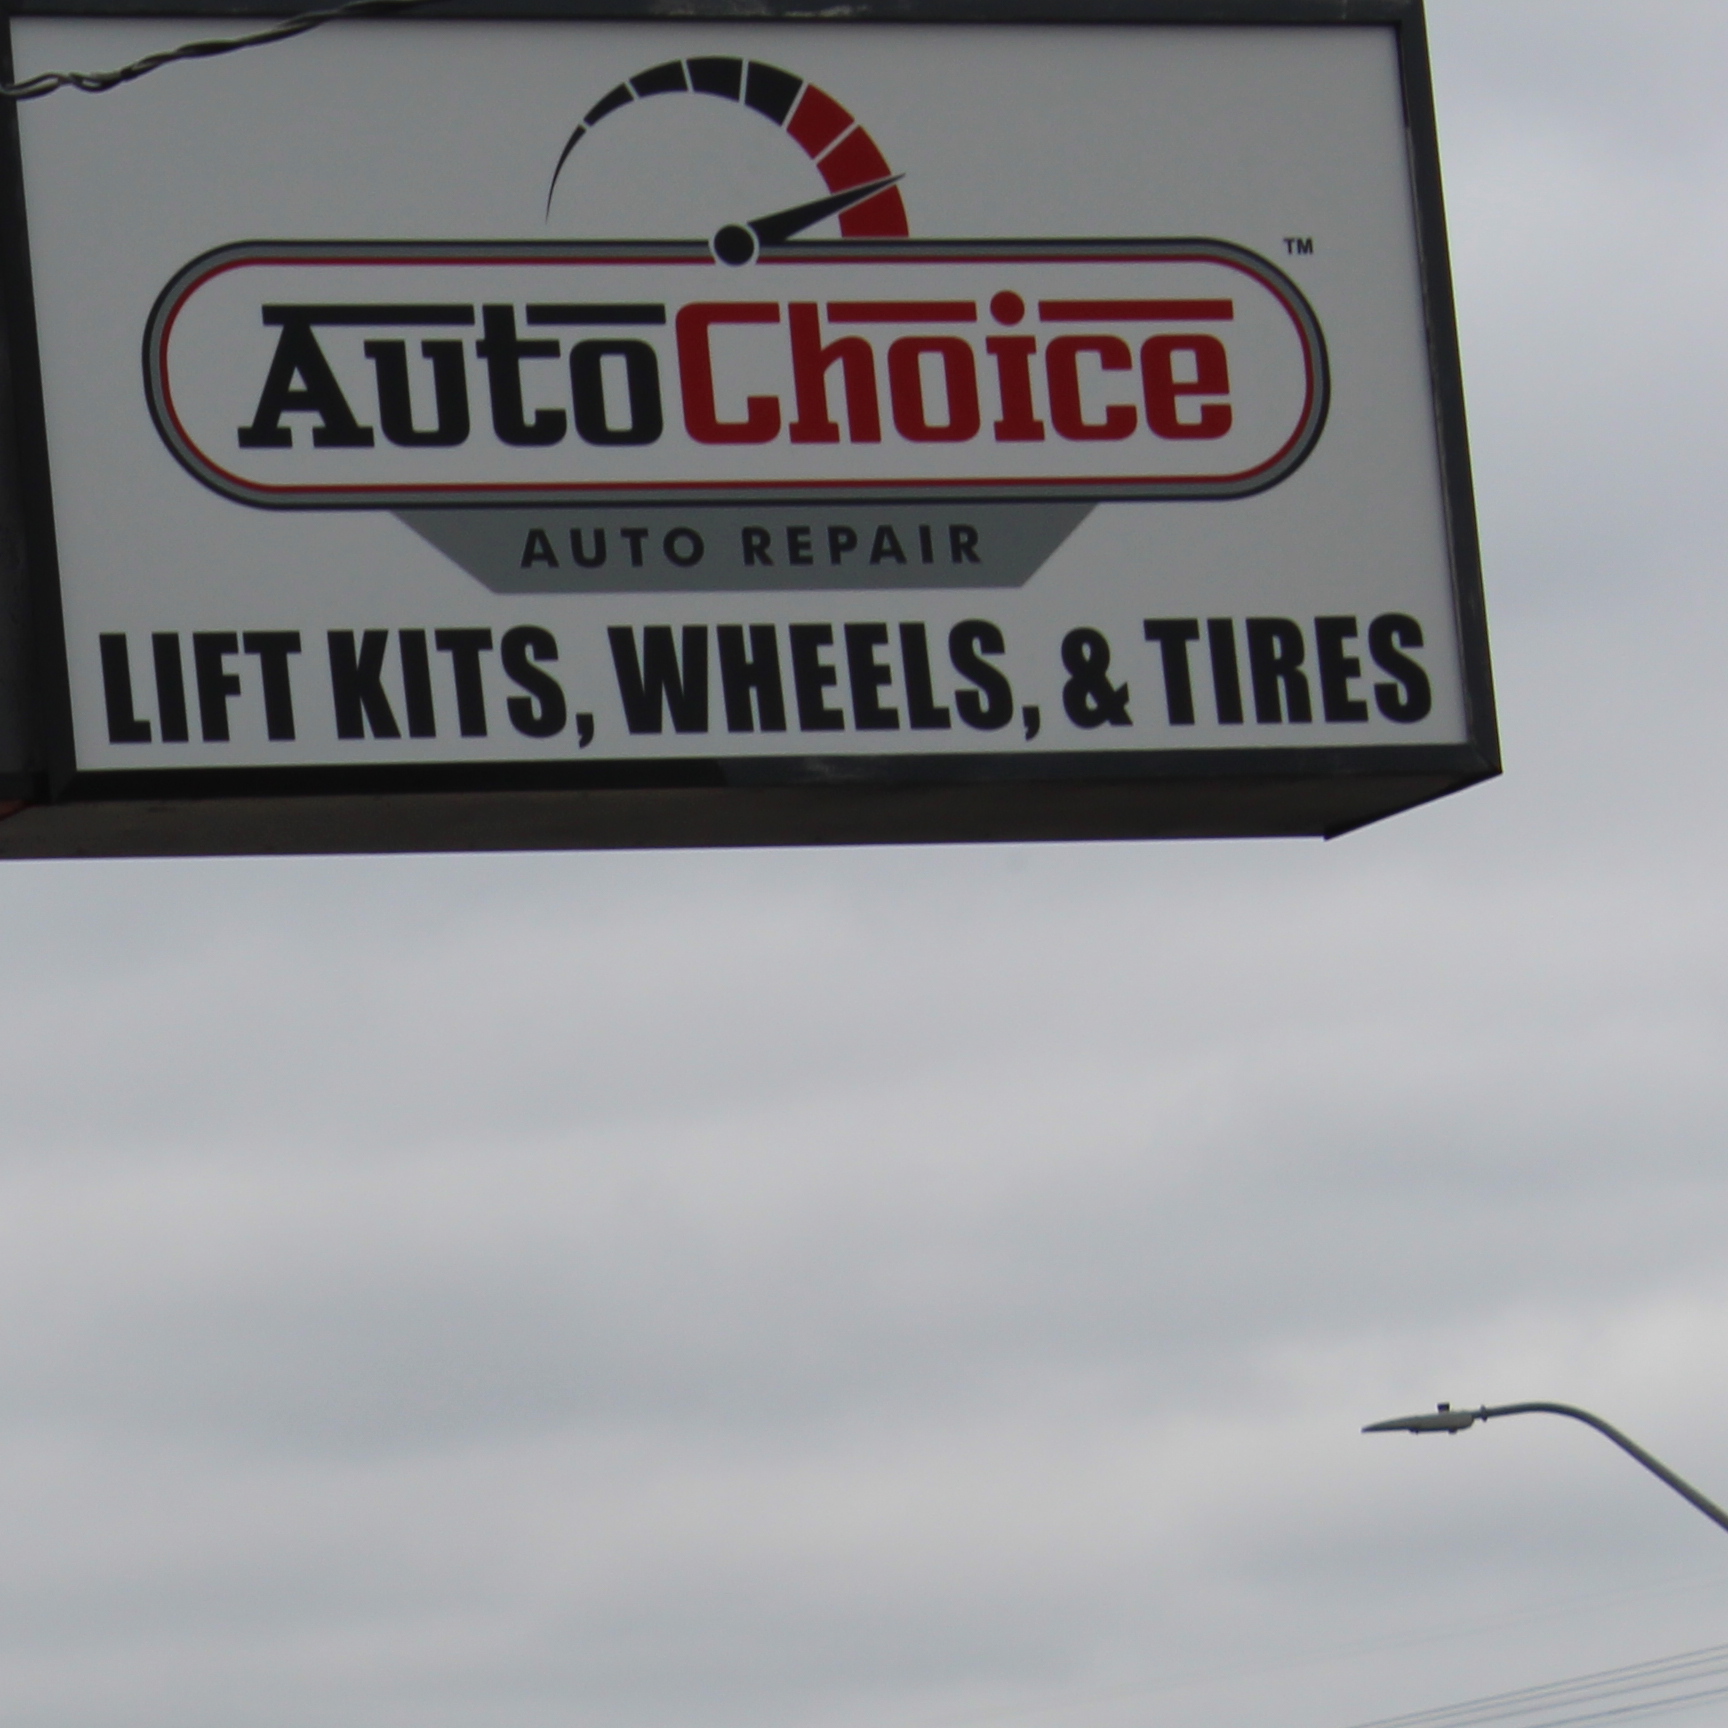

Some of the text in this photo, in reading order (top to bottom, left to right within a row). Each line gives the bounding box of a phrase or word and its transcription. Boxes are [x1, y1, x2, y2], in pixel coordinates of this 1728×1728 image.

[1283, 237, 1314, 255] TM
[519, 523, 983, 571] AUTO REPAIR
[99, 614, 1432, 749] LIFT KITS, WHEELS, & TIRES
